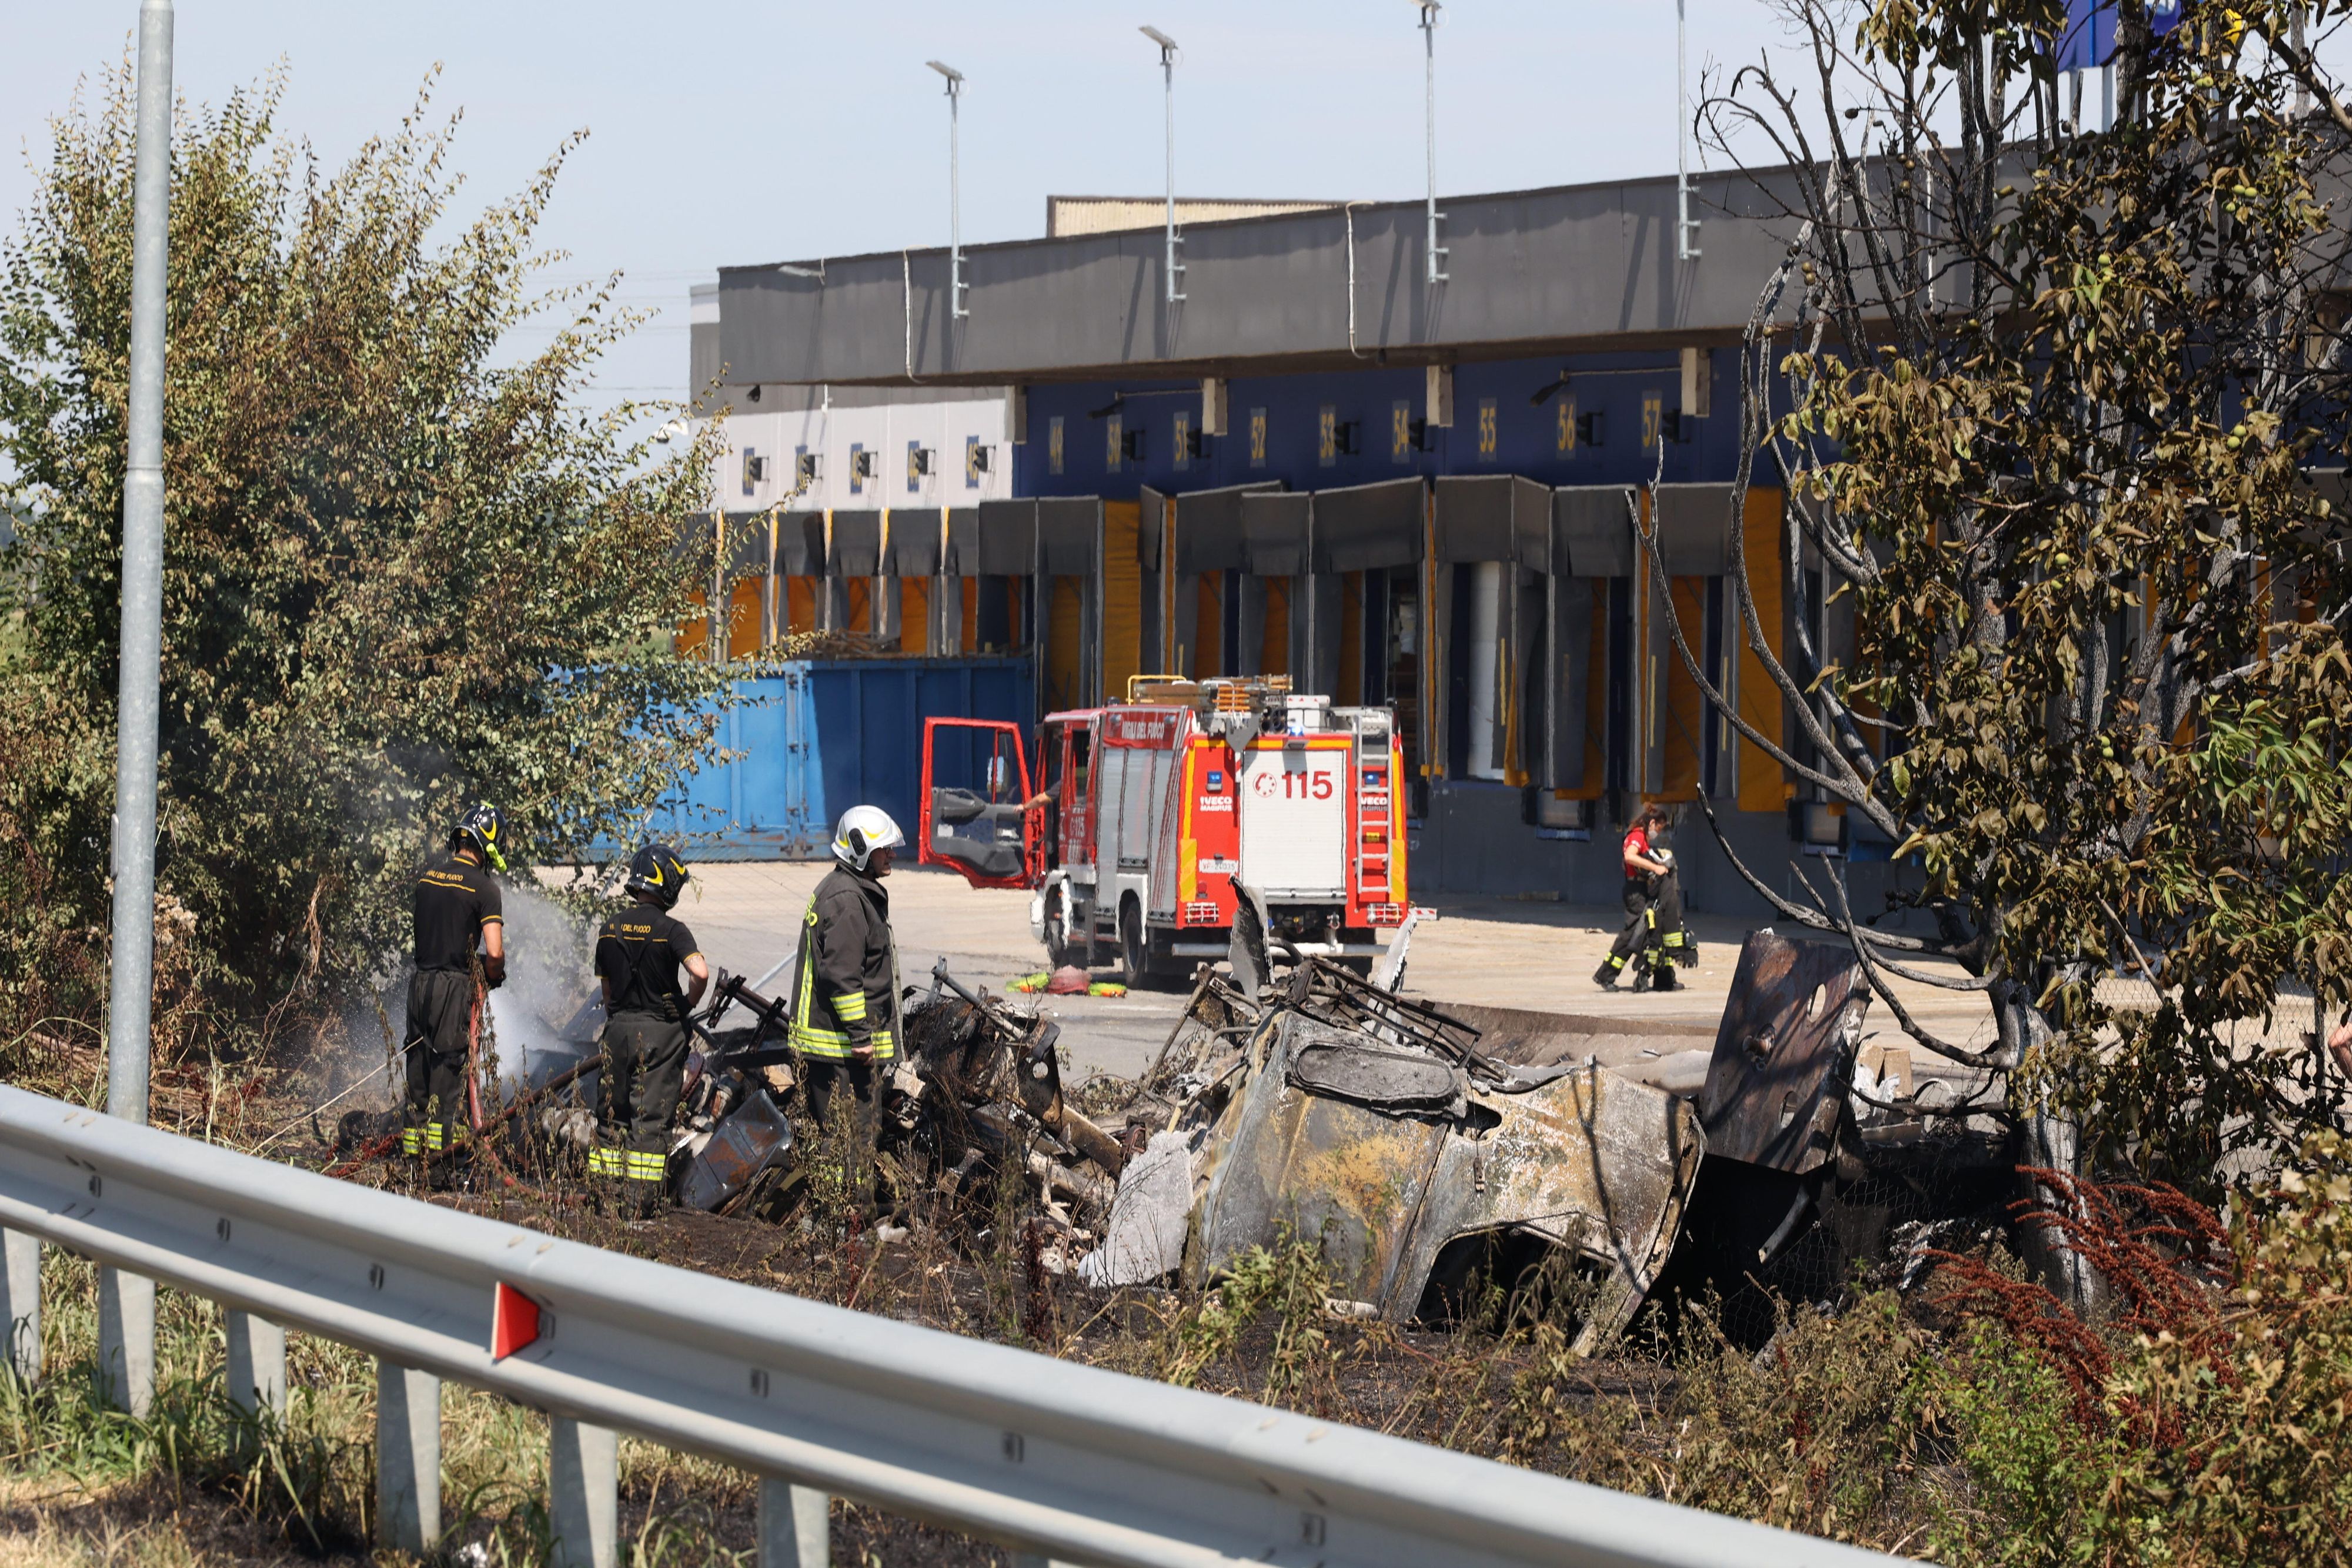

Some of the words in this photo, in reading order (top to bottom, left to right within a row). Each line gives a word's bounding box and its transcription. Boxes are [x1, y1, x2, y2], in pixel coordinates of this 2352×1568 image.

[1175, 420, 1187, 462] 51
[1252, 416, 1266, 459] 52
[1321, 413, 1335, 459] 53
[1394, 409, 1409, 455] 54
[1480, 407, 1496, 452] 55
[1559, 404, 1575, 451] 56
[1643, 399, 1661, 448] 57
[1137, 721, 1146, 739] DEL
[1147, 721, 1165, 739] FUOCO
[1200, 796, 1232, 805] IVECO
[1282, 771, 1332, 800] 115
[1360, 796, 1387, 805] VECO
[622, 924, 633, 932] DEL
[633, 925, 651, 934] FUOCO
